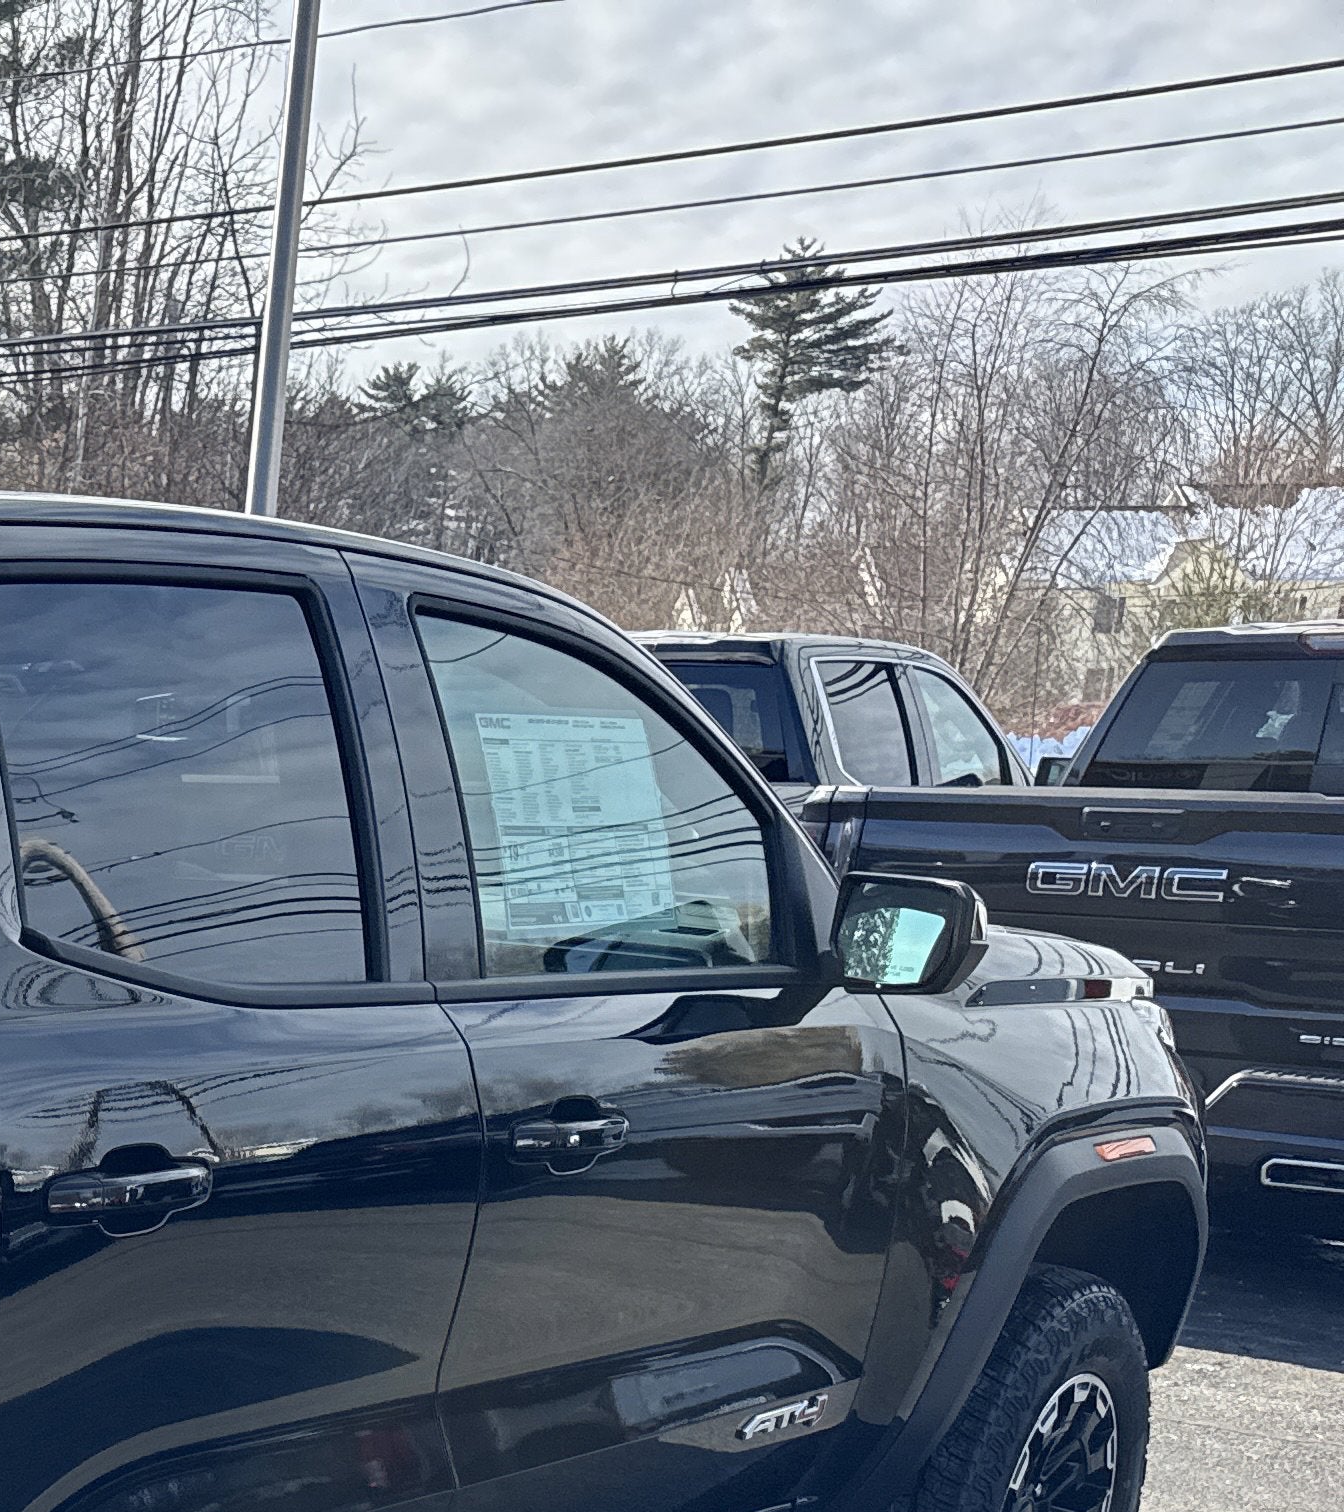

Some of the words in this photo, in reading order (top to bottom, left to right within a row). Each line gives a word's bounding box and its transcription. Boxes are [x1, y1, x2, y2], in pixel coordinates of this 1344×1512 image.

[478, 717, 512, 730] GMC
[1026, 861, 1229, 903] GMC
[1131, 958, 1206, 975] ALI
[735, 1394, 829, 1441] AT4
